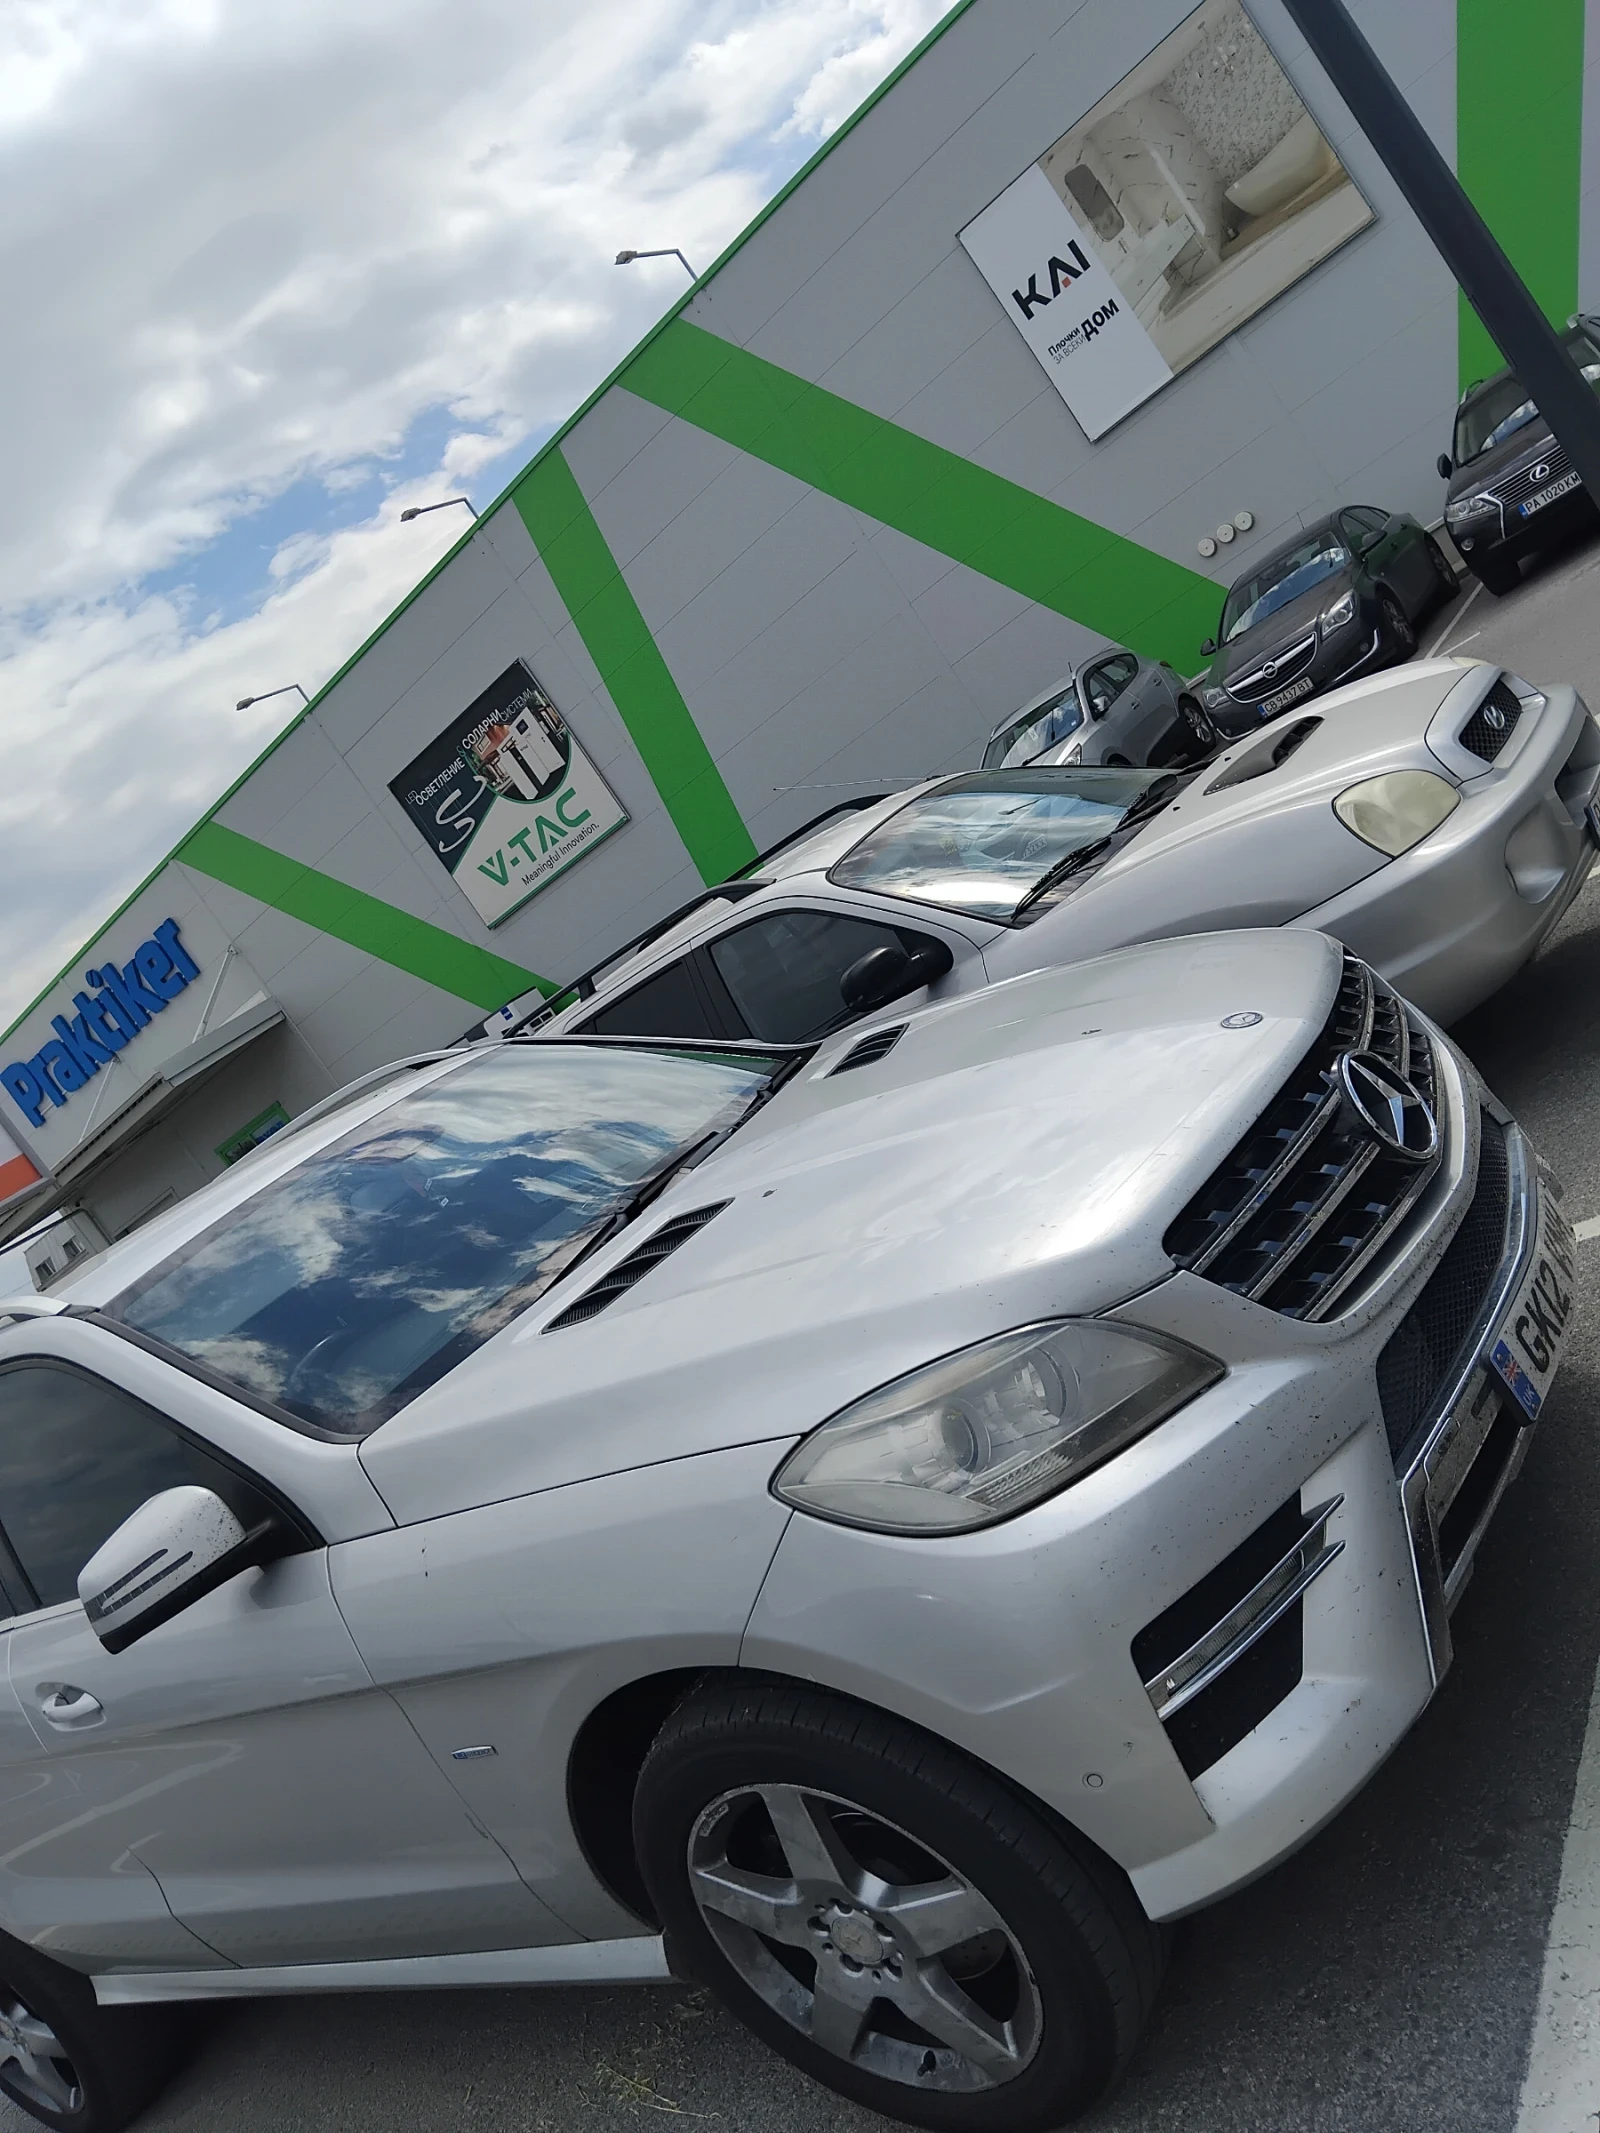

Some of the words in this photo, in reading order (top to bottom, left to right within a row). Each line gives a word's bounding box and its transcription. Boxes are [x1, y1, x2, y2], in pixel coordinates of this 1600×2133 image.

[1011, 239, 1091, 320] KAI
[1048, 327, 1080, 356] Плочки
[1053, 353, 1065, 364] ЗА
[1062, 334, 1086, 357] ВСЕКИ
[1081, 298, 1120, 342] ДОМ
[1525, 498, 1541, 512] PA
[1540, 482, 1565, 502] 1020
[1563, 473, 1580, 488] KM
[1264, 700, 1278, 712] CB
[1296, 679, 1310, 691] BT
[415, 757, 466, 805] ОСВЕТЛЕНИЕ
[461, 708, 503, 749] СОЛАРНИ
[499, 687, 533, 722] СИСТЕМИ
[521, 850, 559, 885] Meaningful
[558, 822, 600, 855] Innovation.
[0, 917, 200, 1128] Praktiker
[1522, 1384, 1535, 1406] UK
